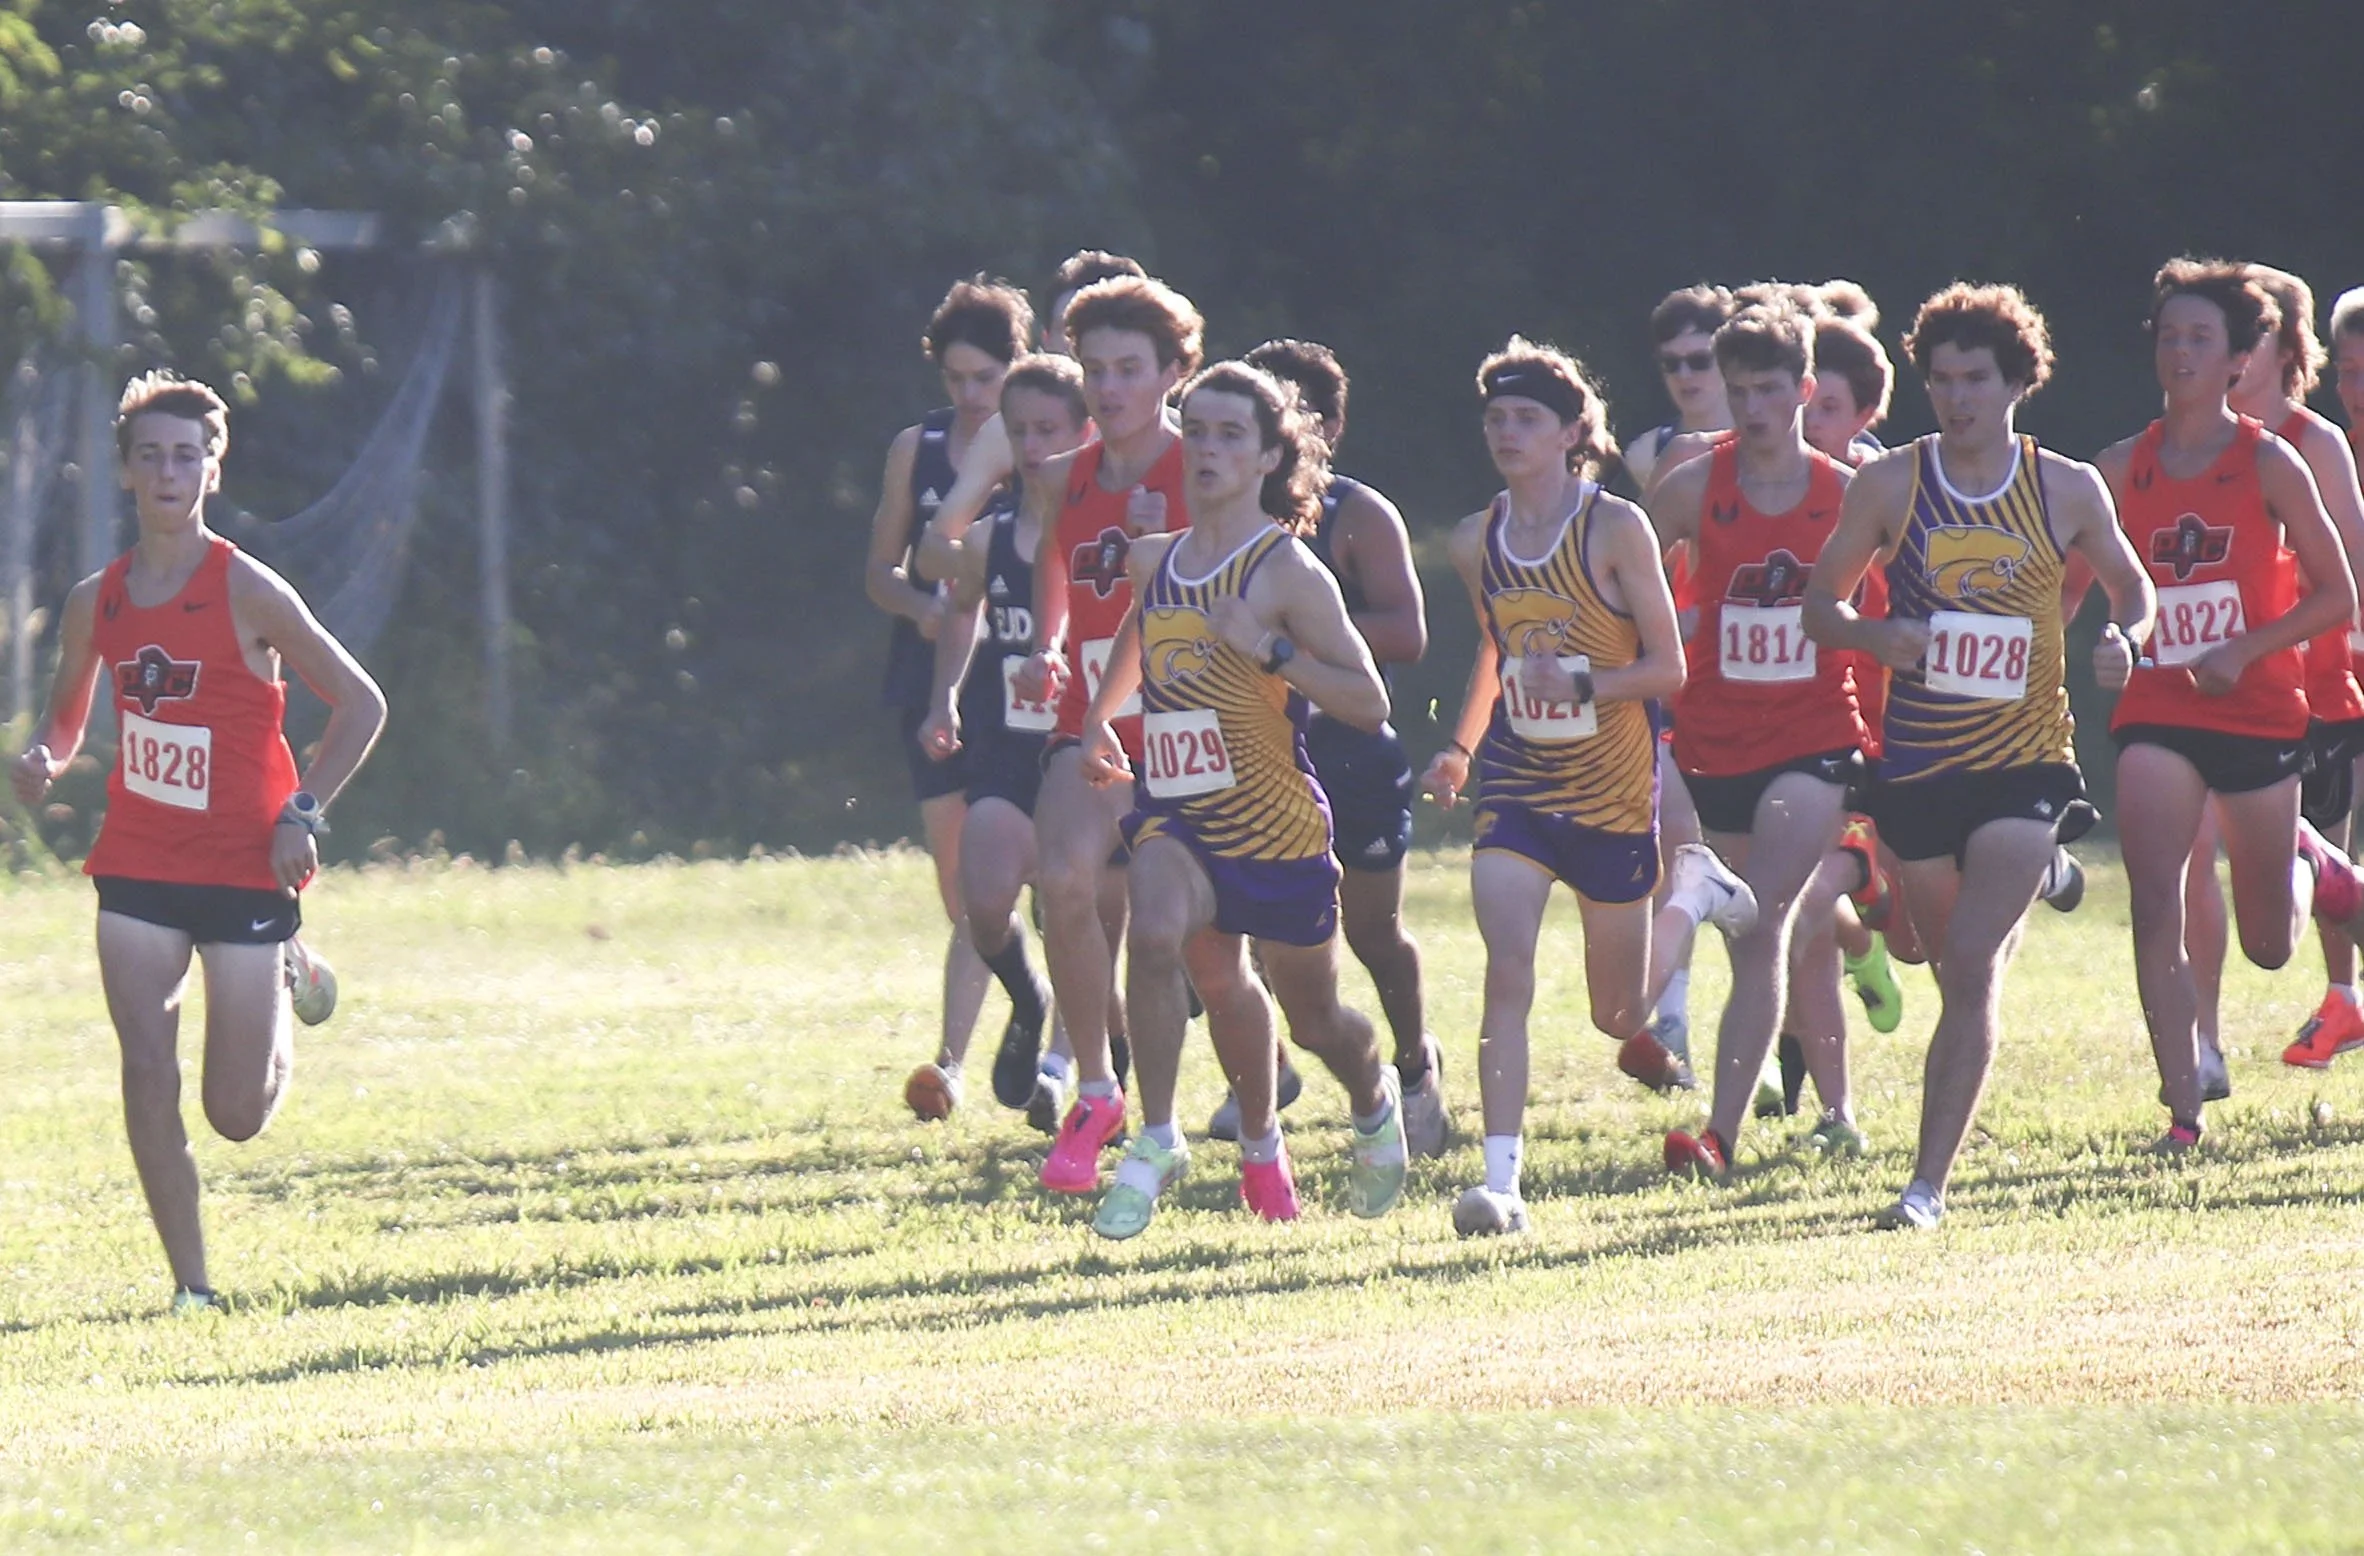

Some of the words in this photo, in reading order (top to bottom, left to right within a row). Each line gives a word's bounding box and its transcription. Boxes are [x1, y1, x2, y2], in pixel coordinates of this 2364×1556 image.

[2156, 596, 2245, 646] 1822
[1932, 629, 2027, 680] 1028
[1506, 675, 1580, 720] 10
[127, 731, 206, 791] 1828
[1147, 727, 1227, 778] 1029
